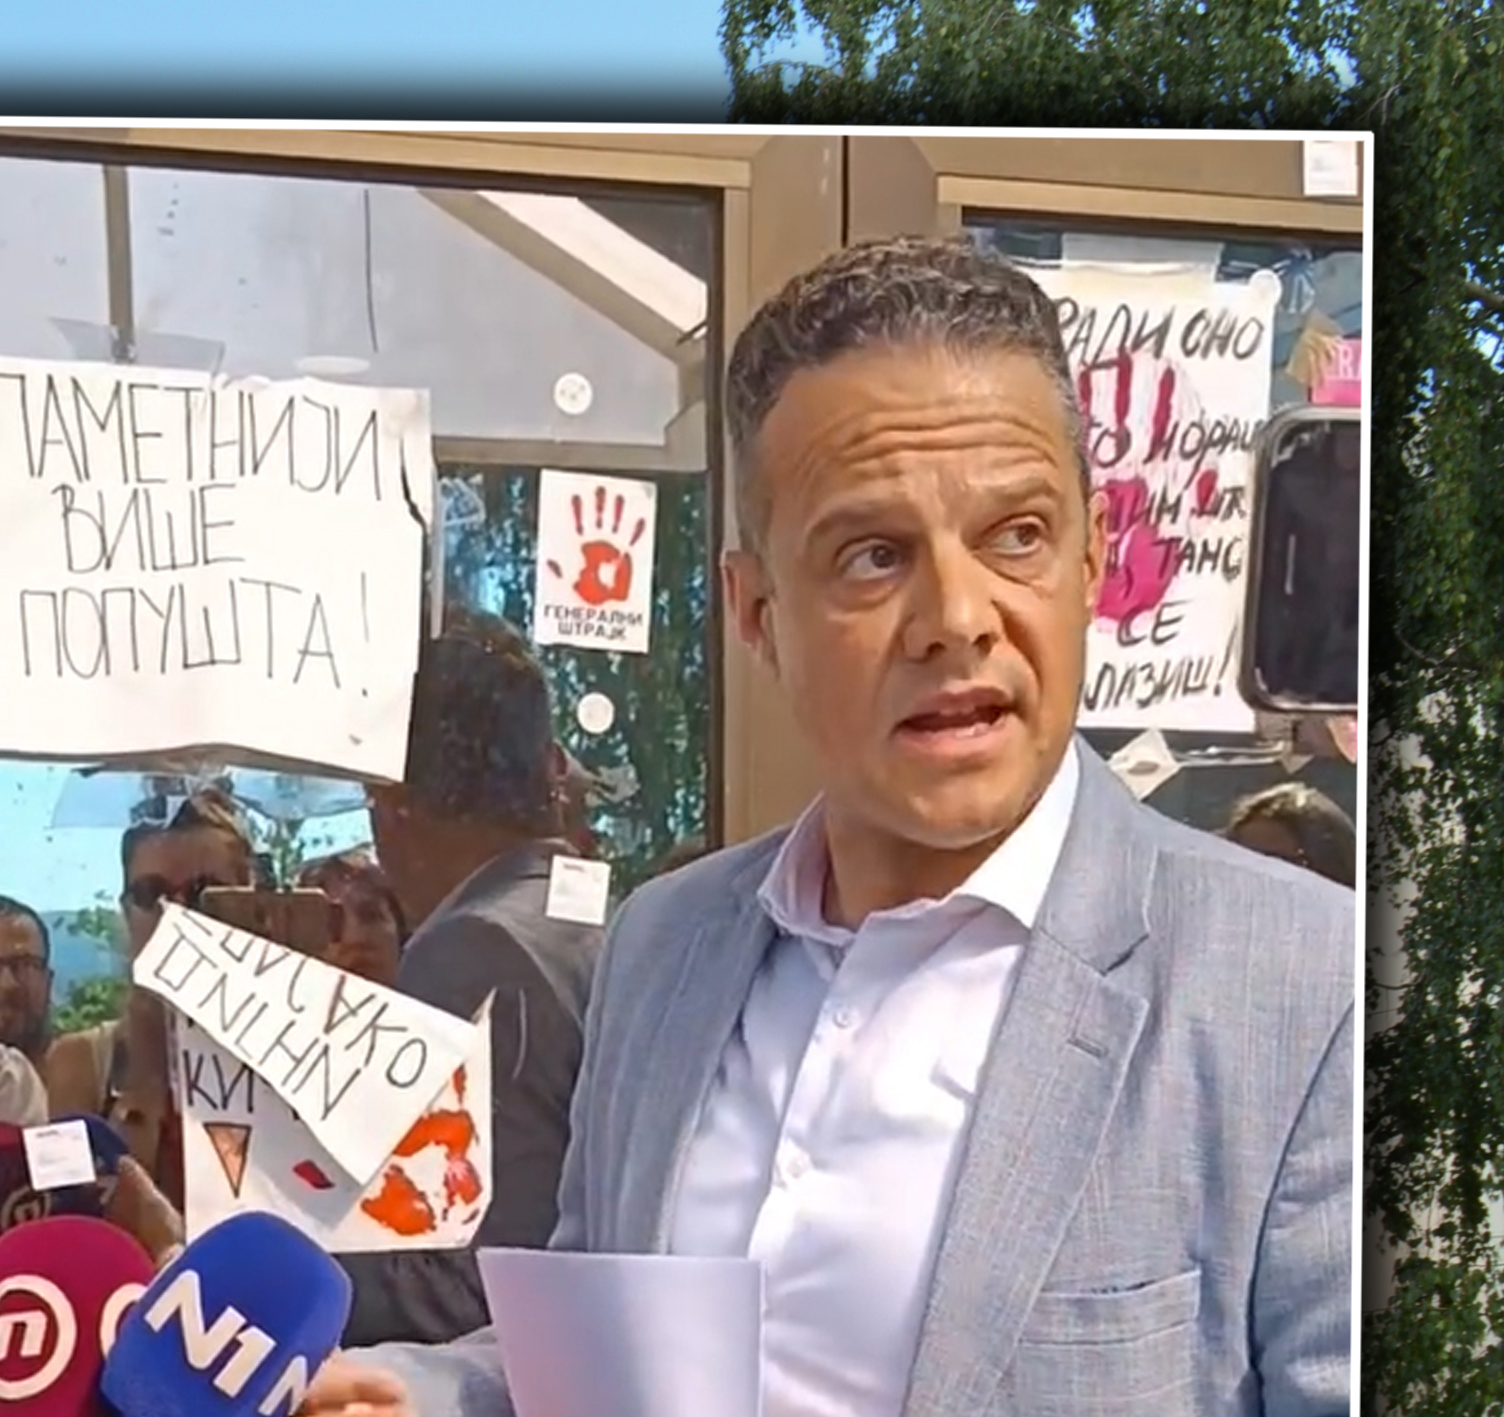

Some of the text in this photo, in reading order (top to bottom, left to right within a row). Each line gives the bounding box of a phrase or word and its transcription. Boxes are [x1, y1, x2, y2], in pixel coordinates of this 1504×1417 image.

[1180, 308, 1265, 360] ОНО
[52, 483, 245, 574] ВИШЕ
[1117, 598, 1192, 647] СЕ
[143, 1269, 277, 1398] N1
